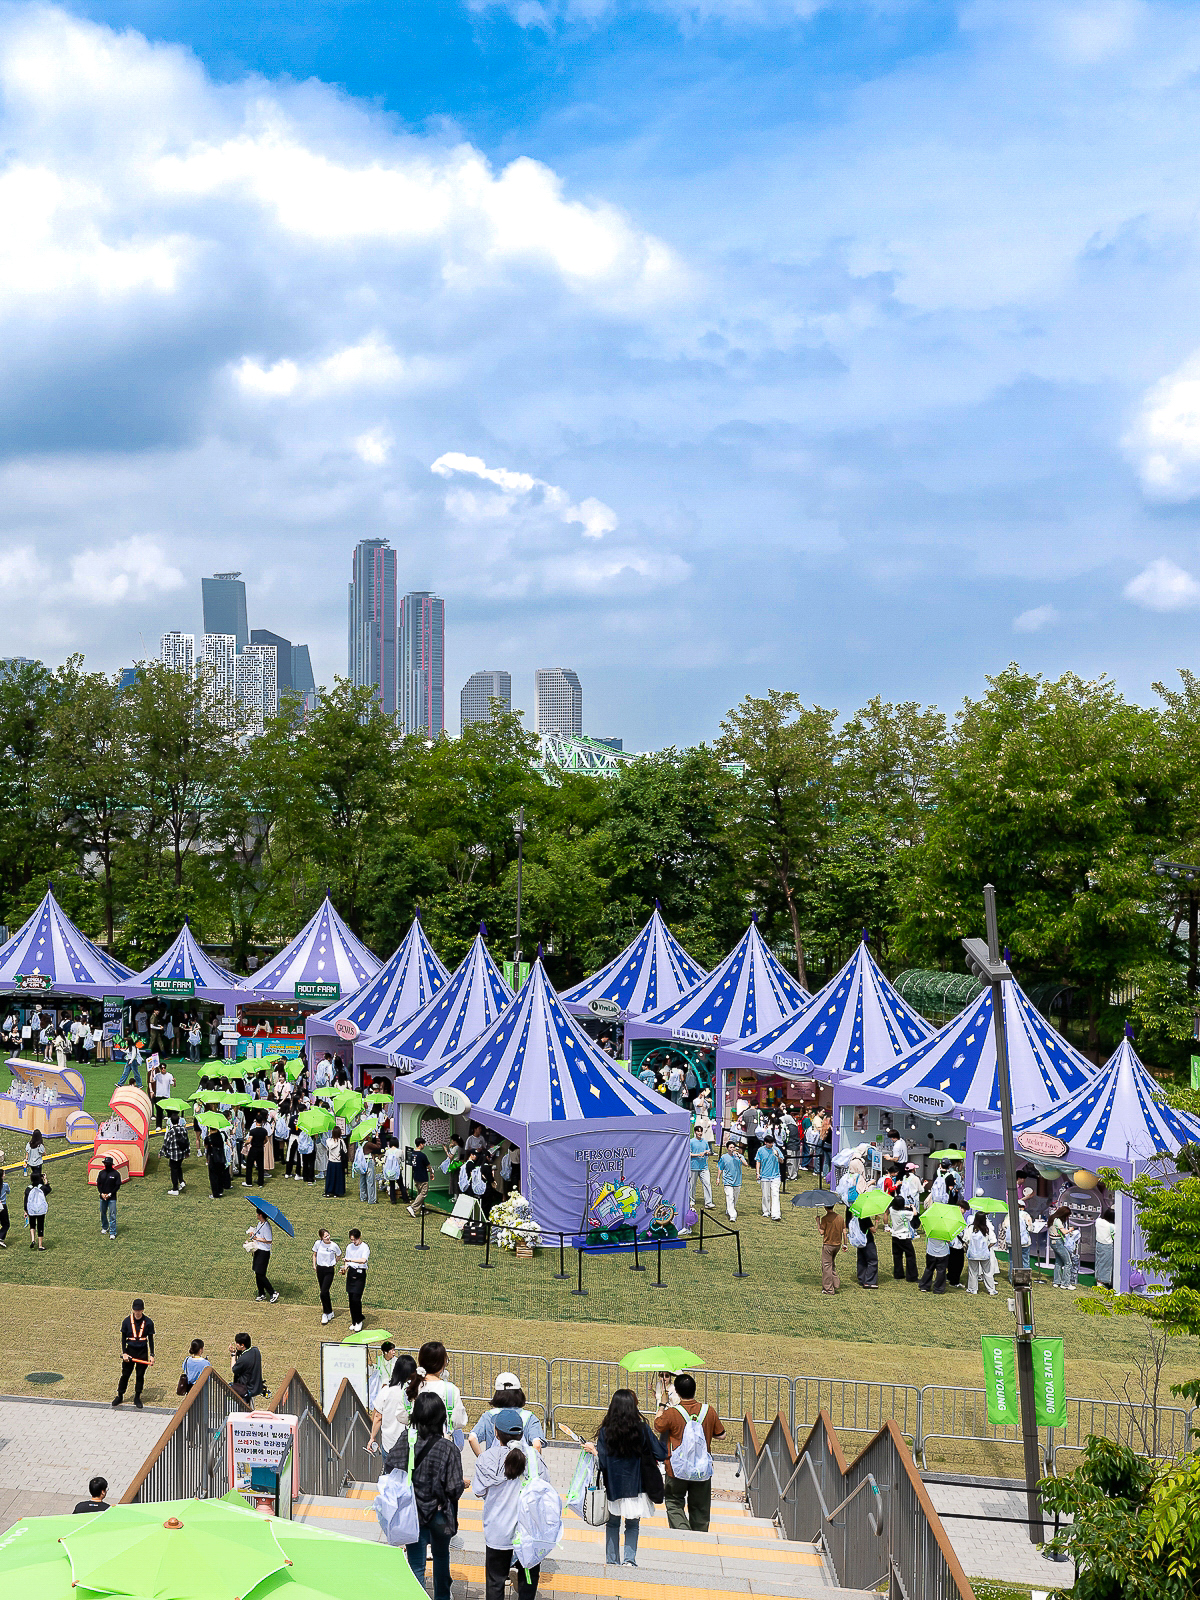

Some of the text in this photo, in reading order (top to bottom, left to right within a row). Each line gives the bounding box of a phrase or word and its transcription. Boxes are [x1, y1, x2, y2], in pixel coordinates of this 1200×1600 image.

[153, 980, 192, 989] ROOT FARM
[298, 985, 337, 993] ROOT FARM
[908, 1093, 945, 1108] FORMENT
[574, 1147, 637, 1161] PERSONAL
[589, 1160, 623, 1173] CARE
[993, 1348, 1007, 1411] OLIVE YOUNG
[1043, 1350, 1056, 1414] OLIVE YOUNG
[237, 1439, 261, 1447] 쓰레기는
